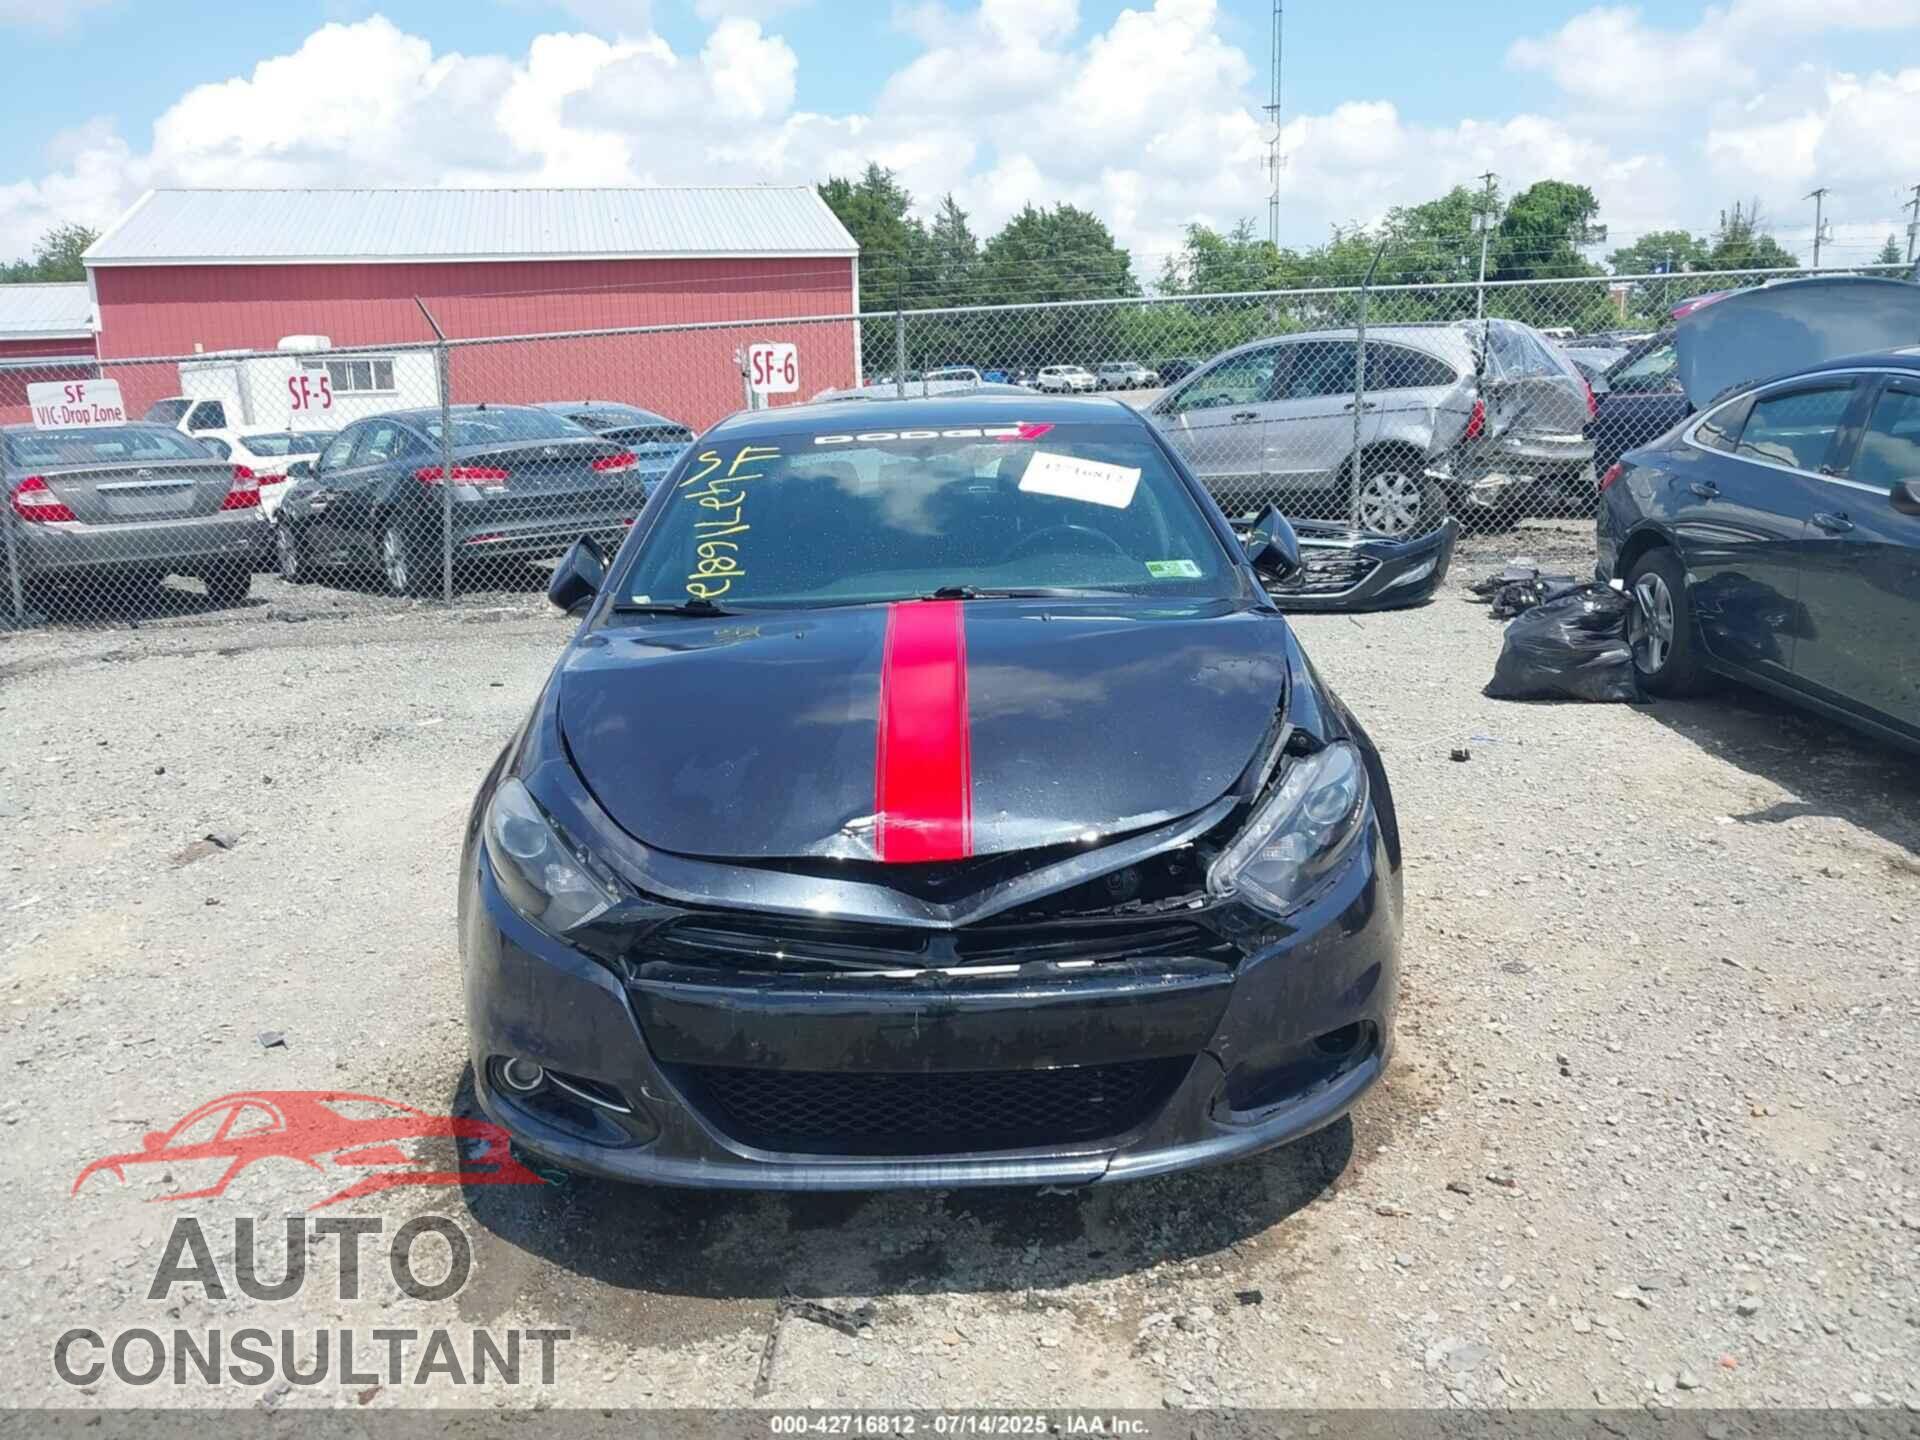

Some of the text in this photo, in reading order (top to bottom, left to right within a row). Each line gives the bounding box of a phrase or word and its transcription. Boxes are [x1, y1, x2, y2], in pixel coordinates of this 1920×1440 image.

[752, 351, 795, 385] SF-6
[63, 384, 86, 404] SF
[288, 376, 332, 410] SF-5
[91, 403, 122, 423] Zone
